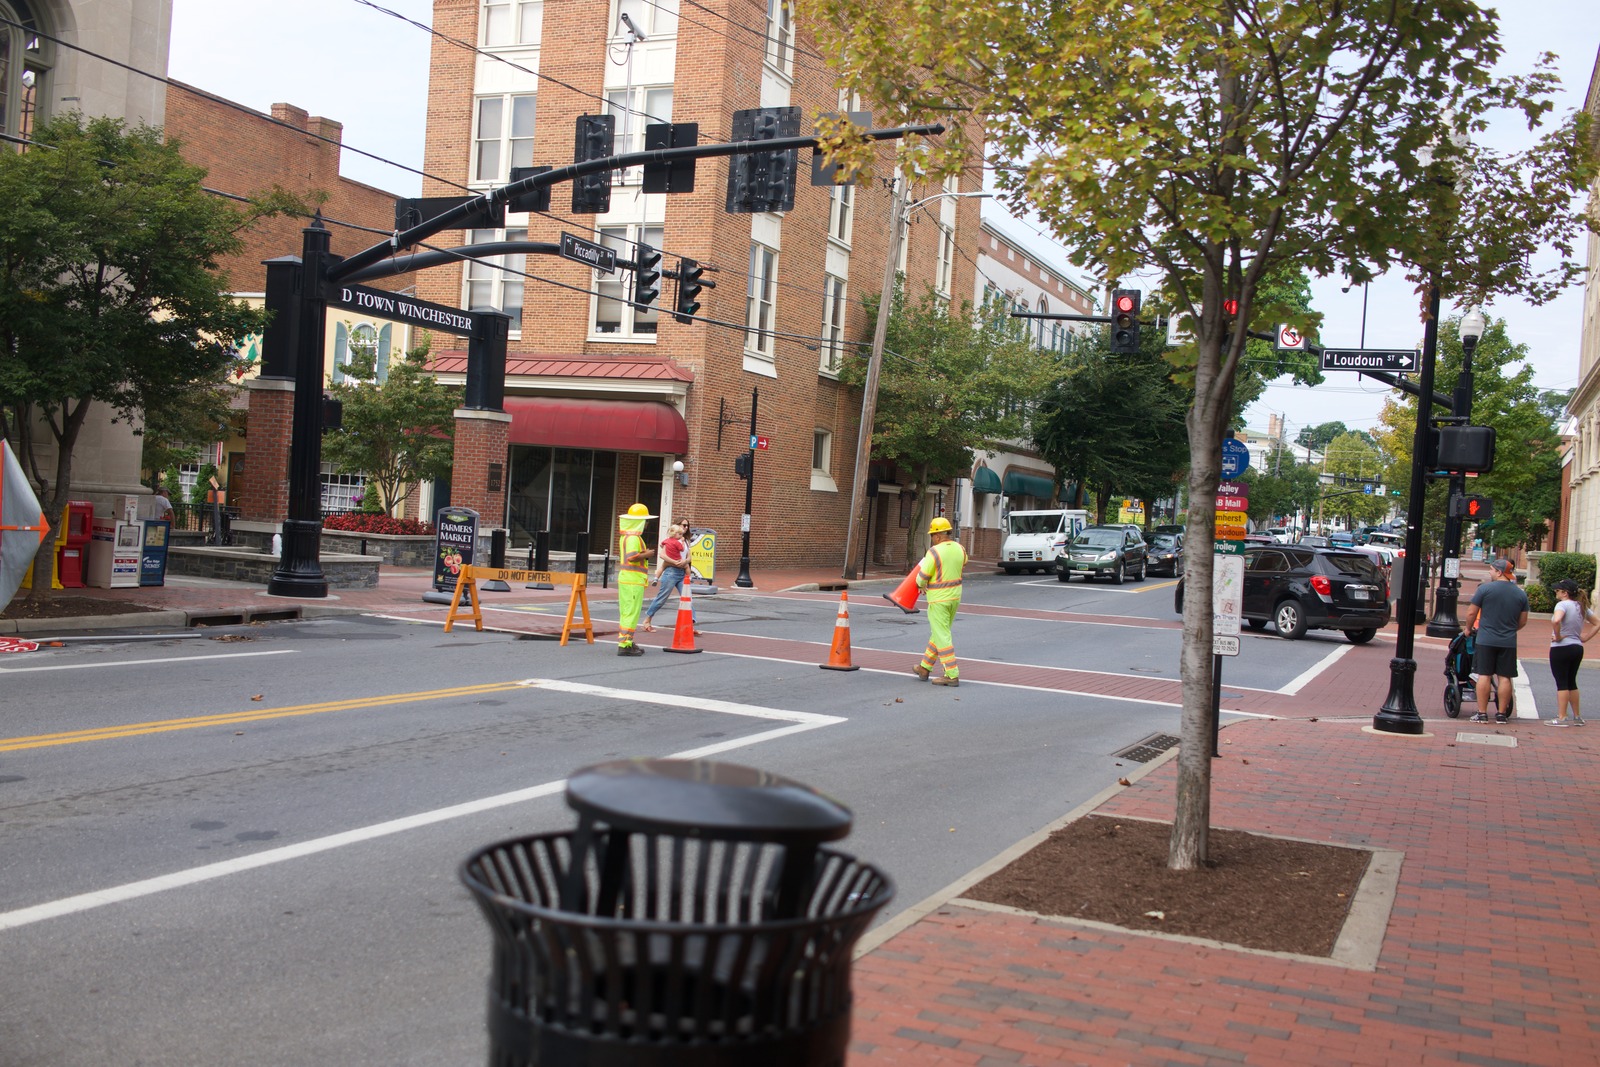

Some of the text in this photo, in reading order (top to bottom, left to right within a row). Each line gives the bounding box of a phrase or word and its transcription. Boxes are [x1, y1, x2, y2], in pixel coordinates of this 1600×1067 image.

[574, 243, 600, 264] Piccadilly
[356, 291, 394, 312] TOWN
[398, 301, 472, 330] WINCHESTER
[1333, 354, 1383, 366] Loudoun
[751, 437, 757, 447] P
[1229, 445, 1248, 453] Stop
[1225, 499, 1241, 507] Mall
[1215, 512, 1242, 522] mherst
[441, 522, 473, 534] FARMERS
[440, 531, 472, 543] MARKET
[498, 570, 551, 581] DO NOT ENTER
